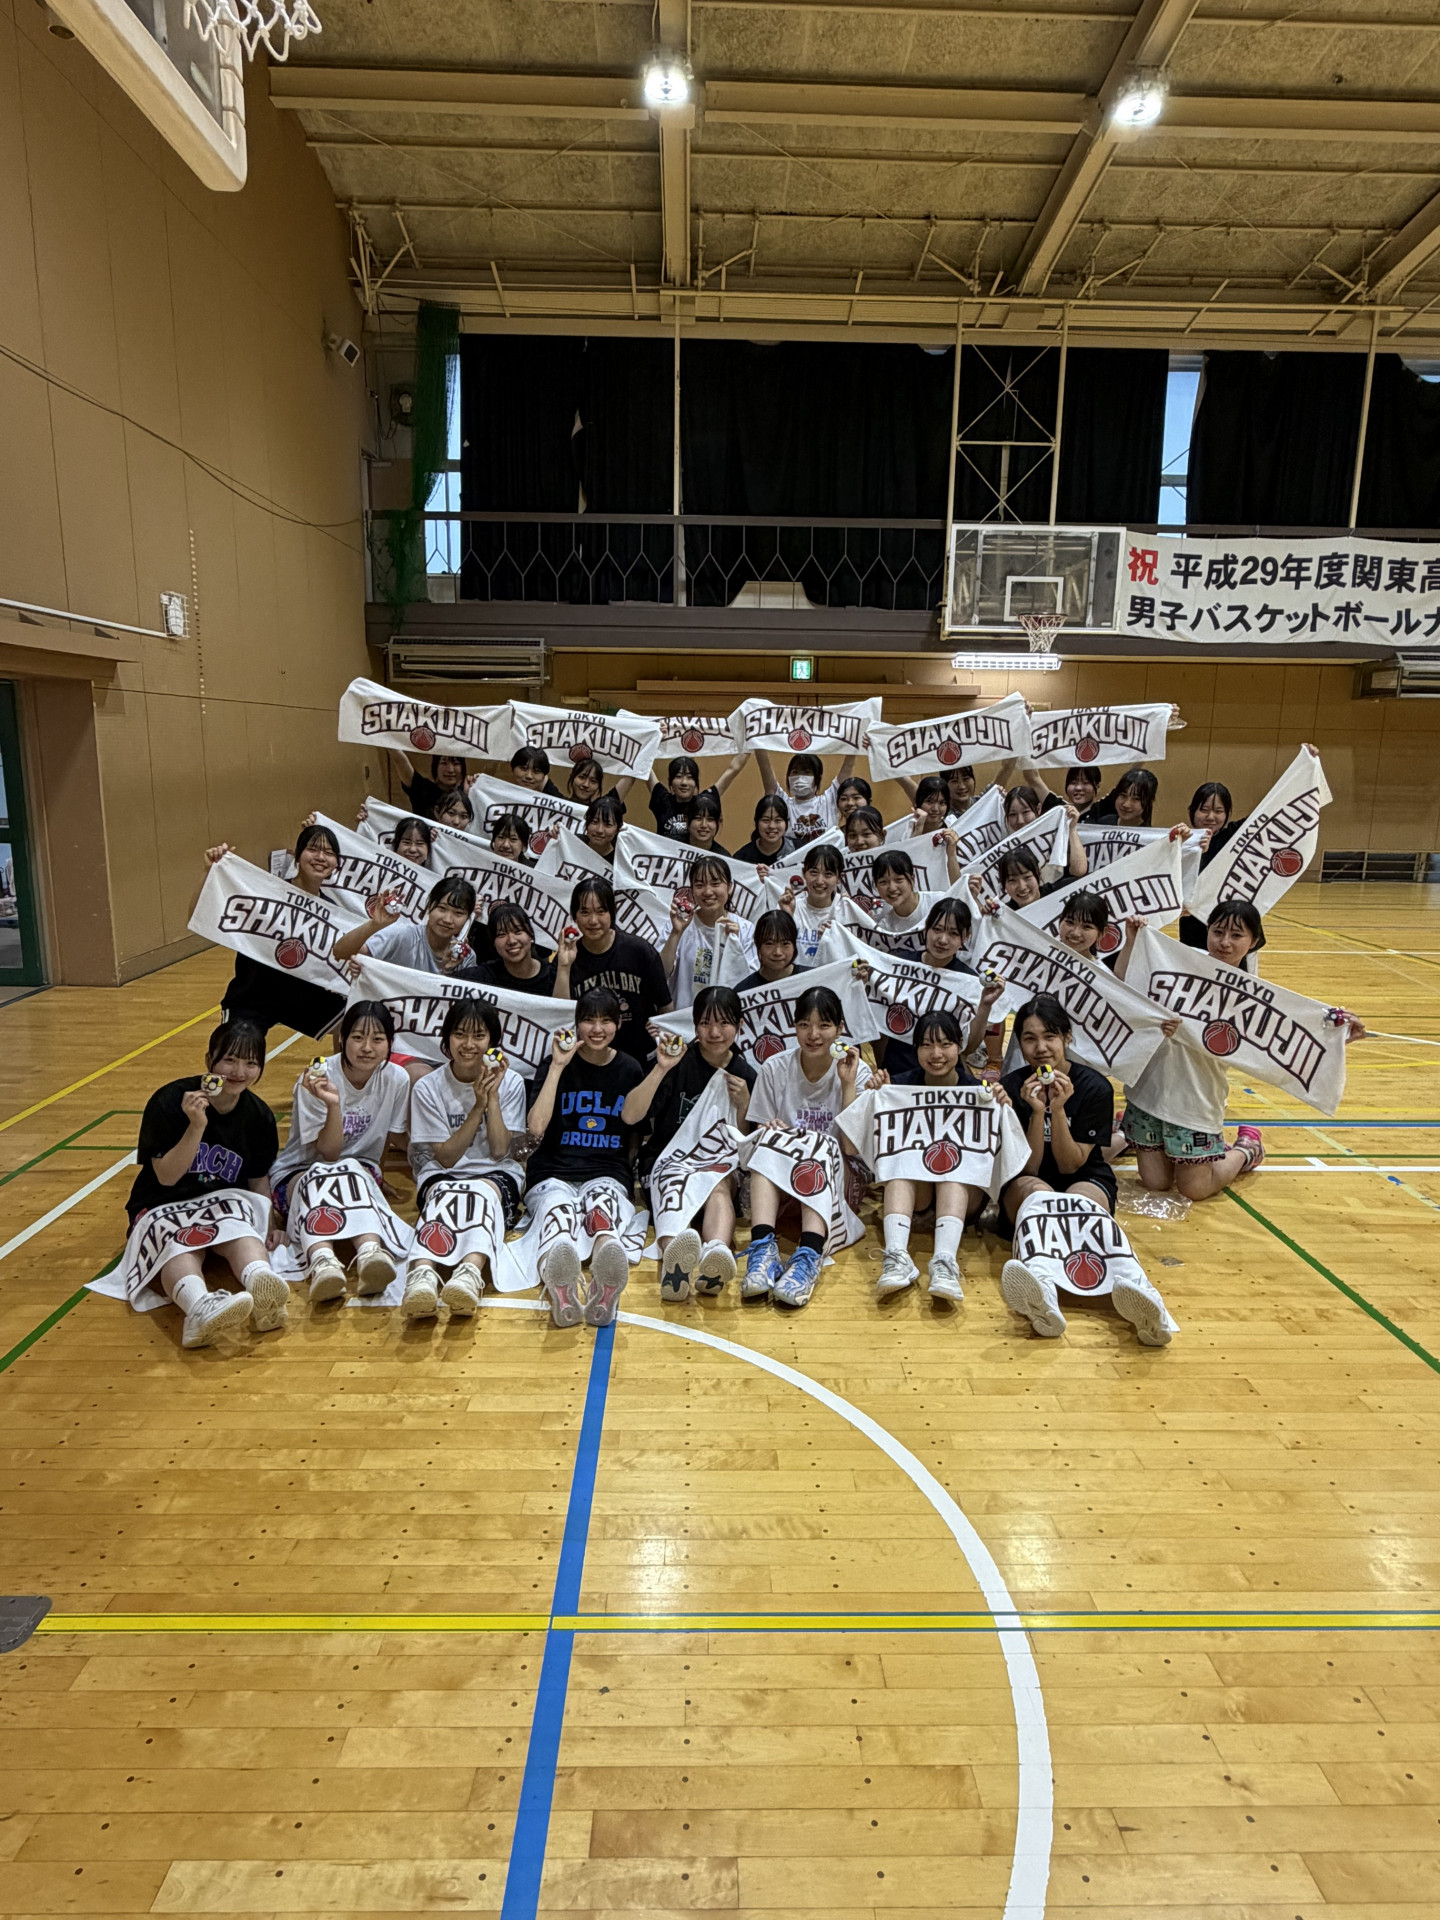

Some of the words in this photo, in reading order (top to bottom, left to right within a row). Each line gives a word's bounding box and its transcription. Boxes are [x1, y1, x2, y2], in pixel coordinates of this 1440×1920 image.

[1128, 546, 1159, 586] 祝
[567, 712, 606, 726] TOKYO
[744, 707, 861, 750] SHAKUJII
[526, 720, 642, 770] SHAKUJII
[1031, 713, 1150, 759] SHAKUJII
[533, 796, 573, 815] TOKYO
[1101, 831, 1140, 843] TOKYO
[1230, 813, 1269, 855] TOKYO
[980, 837, 1021, 868] TOKYO
[376, 853, 418, 881] TOKYO
[492, 862, 534, 884] TOKYO
[286, 891, 331, 921] TOKYO
[892, 963, 941, 985] TOKYO
[1048, 945, 1096, 983] TOKYO
[440, 984, 498, 1006] TOKYO
[620, 971, 641, 995] DAY
[1215, 968, 1275, 1003] TOKYO
[740, 989, 781, 1009] OKYO
[1148, 971, 1326, 1092] SHAKUJII
[561, 1090, 624, 1115] UCLA
[912, 1091, 976, 1105] TOKYO
[561, 1131, 620, 1148] BRUINS
[1042, 1198, 1105, 1213] TOKY
